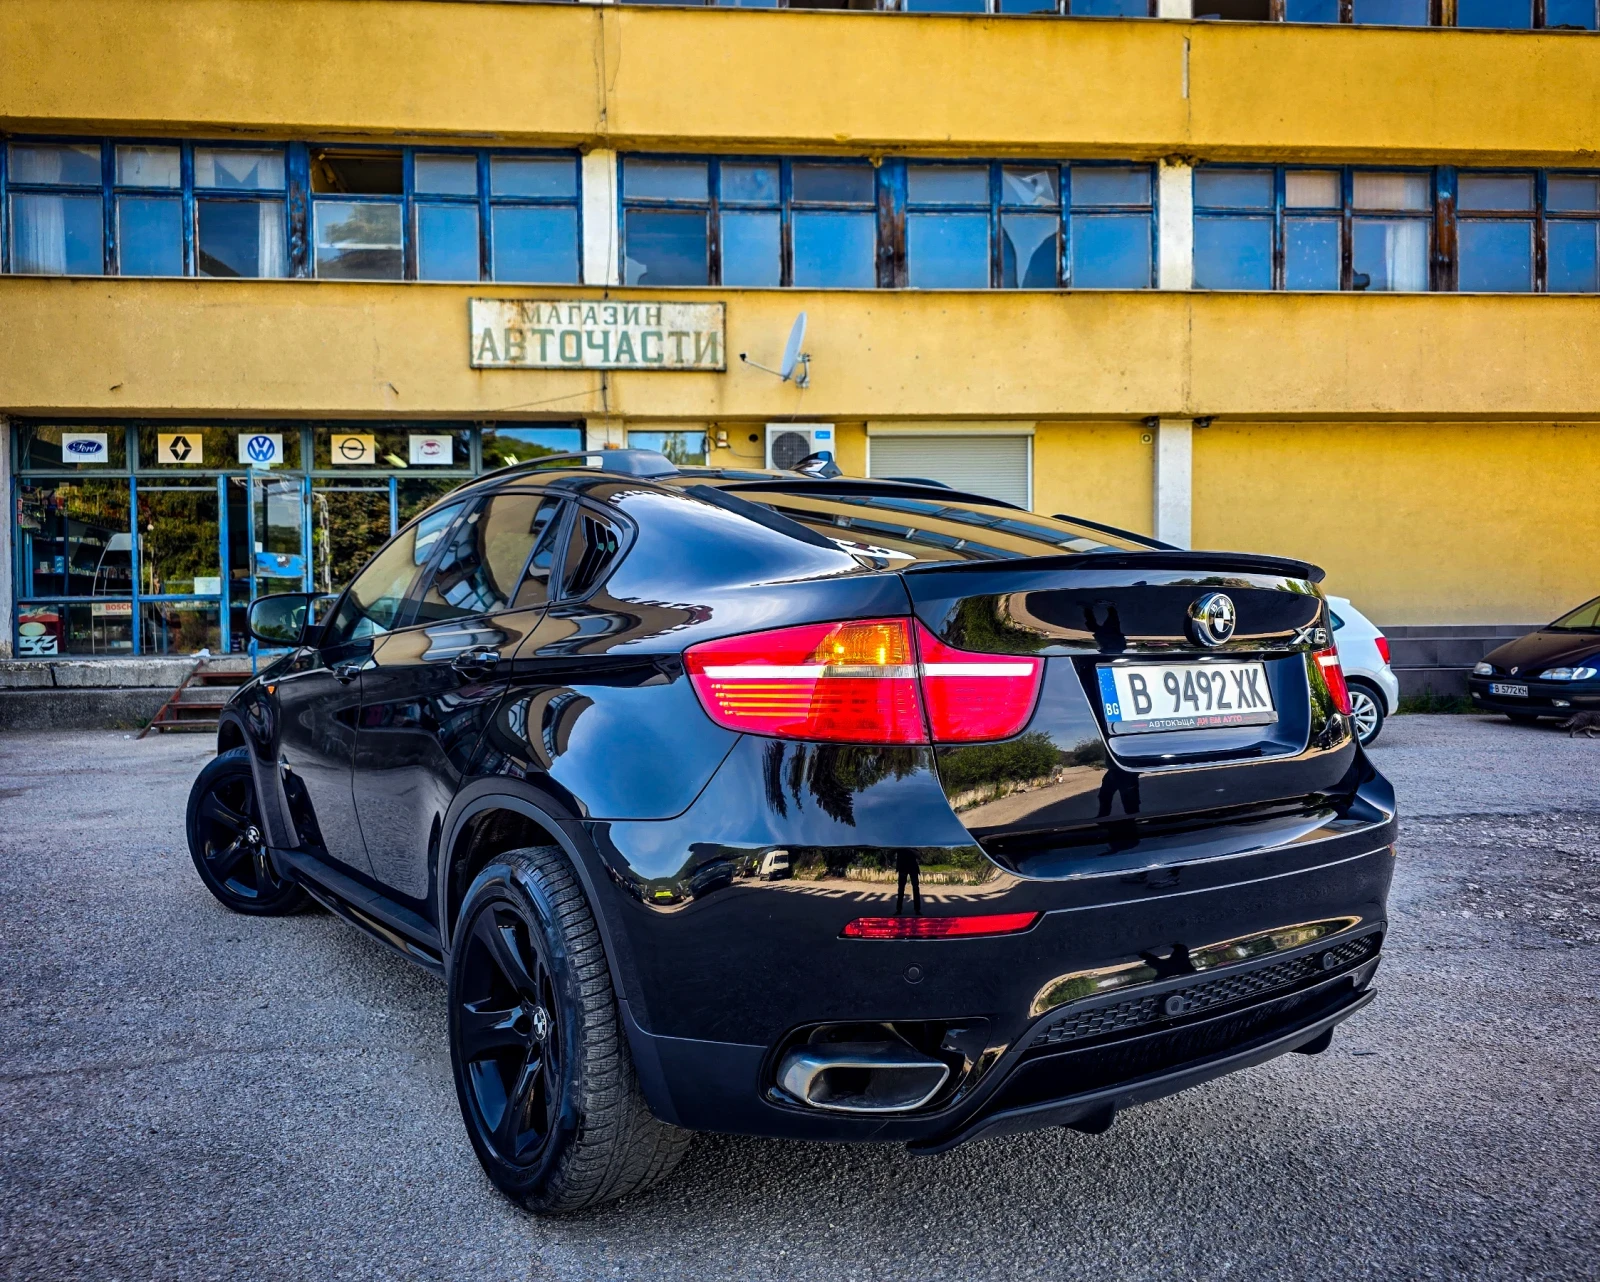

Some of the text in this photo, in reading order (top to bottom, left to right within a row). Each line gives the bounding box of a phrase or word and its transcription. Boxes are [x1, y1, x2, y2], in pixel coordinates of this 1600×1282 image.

[521, 305, 662, 326] МАГАЗИН
[476, 327, 718, 364] АВТОЧАСТИ
[72, 442, 99, 453] Ford
[105, 603, 132, 611] BOSCH
[1291, 627, 1327, 644] X6
[1128, 673, 1153, 716] B
[1163, 669, 1232, 713] 9492
[1105, 702, 1120, 716] BG
[1148, 718, 1195, 728] АВТОКЪЩА
